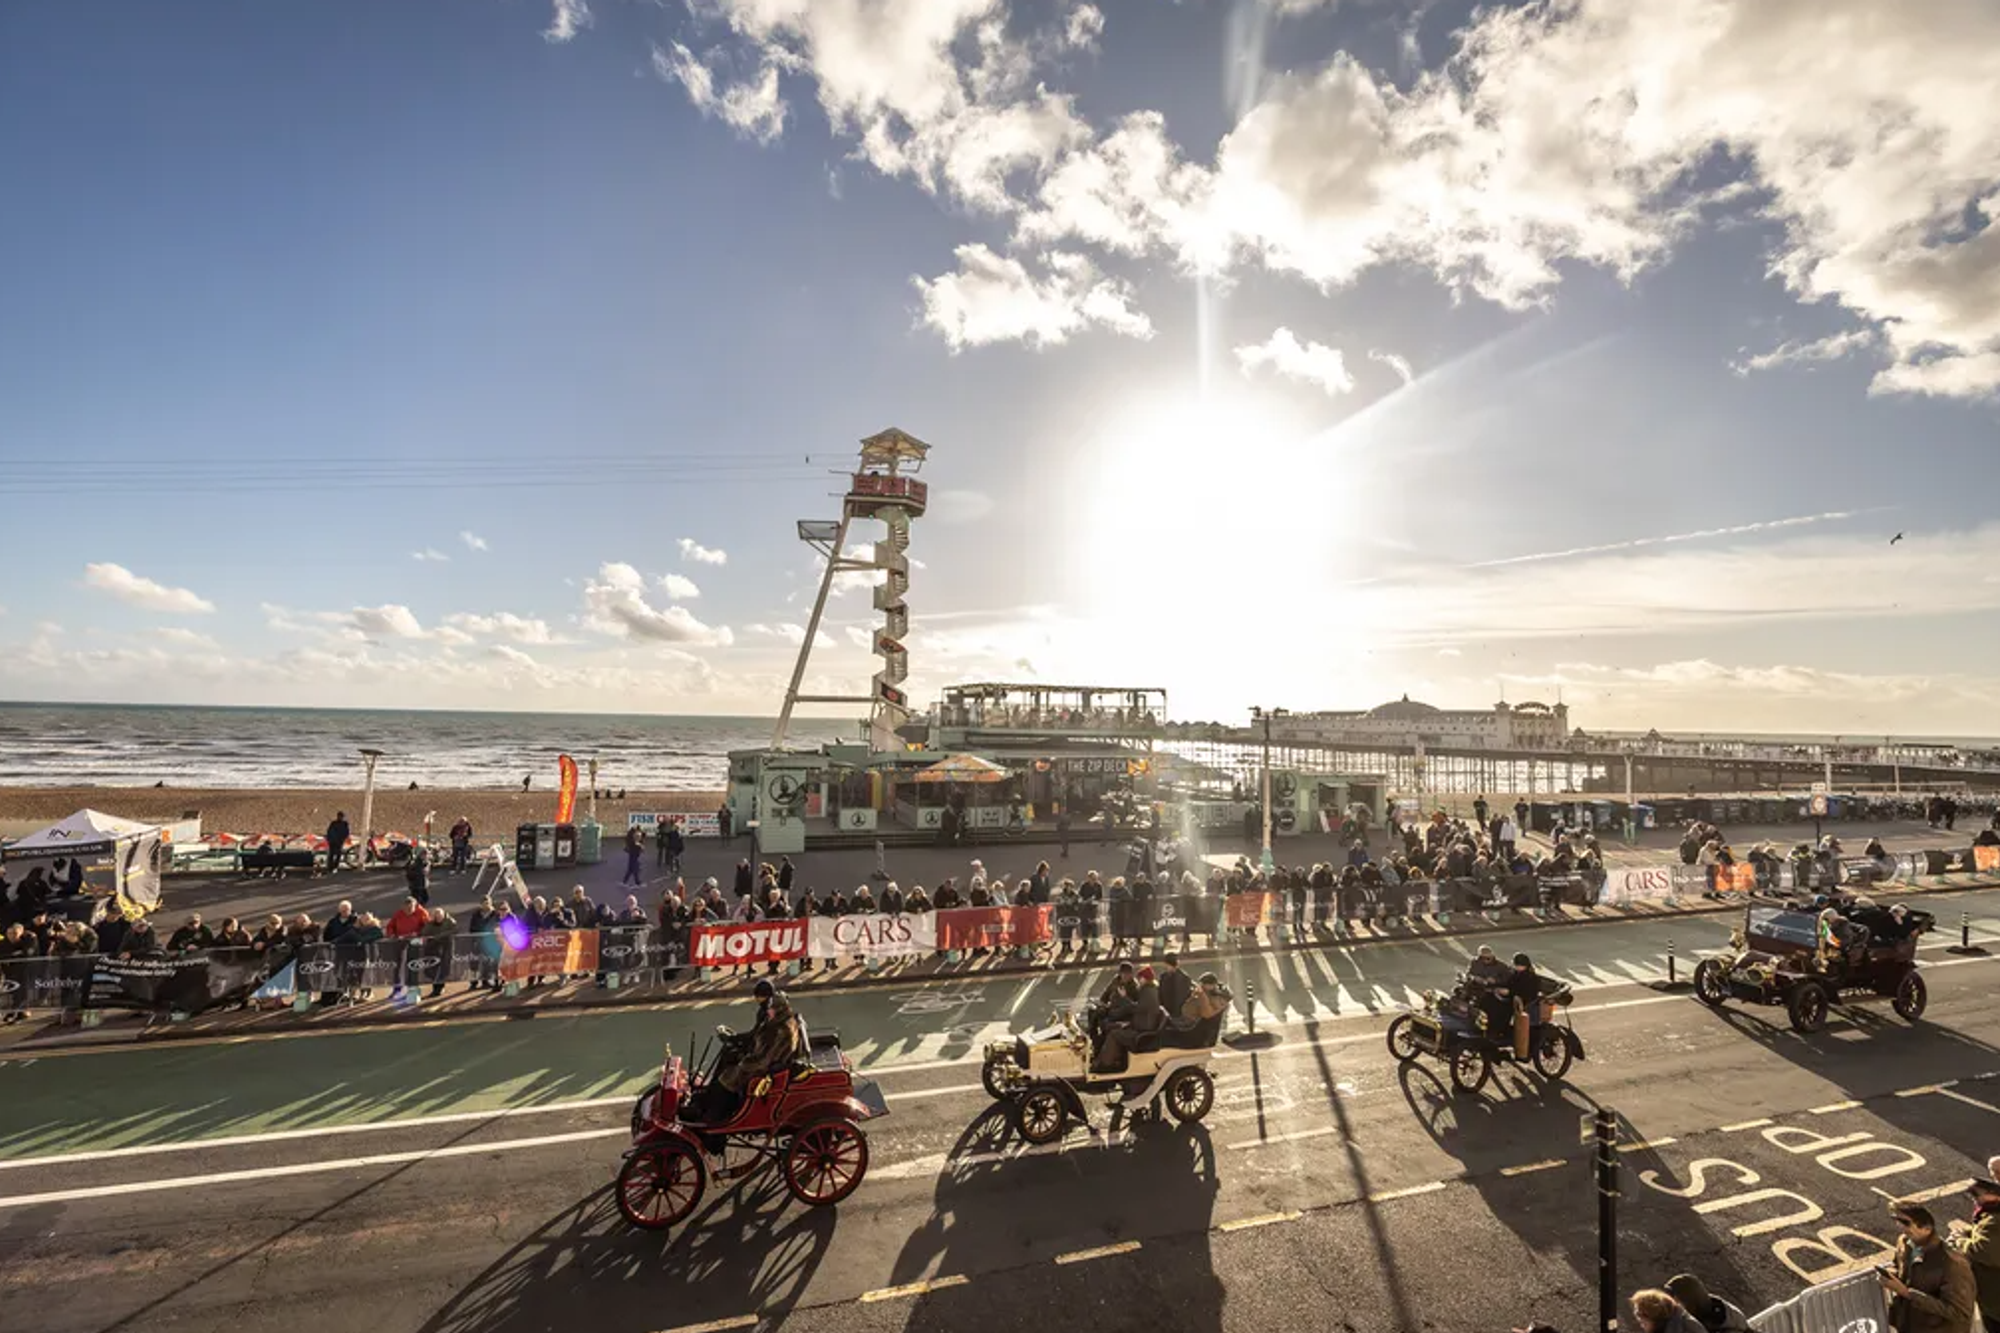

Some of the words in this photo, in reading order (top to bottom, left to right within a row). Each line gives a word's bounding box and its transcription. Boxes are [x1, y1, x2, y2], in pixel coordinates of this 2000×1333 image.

[1067, 759, 1085, 773] THE
[1087, 759, 1102, 773] ZIP
[1103, 759, 1127, 773] DECK
[1625, 869, 1669, 891] CARS
[694, 926, 804, 959] MOTUL
[833, 916, 912, 945] CARS
[1639, 1157, 1898, 1286] BUS
